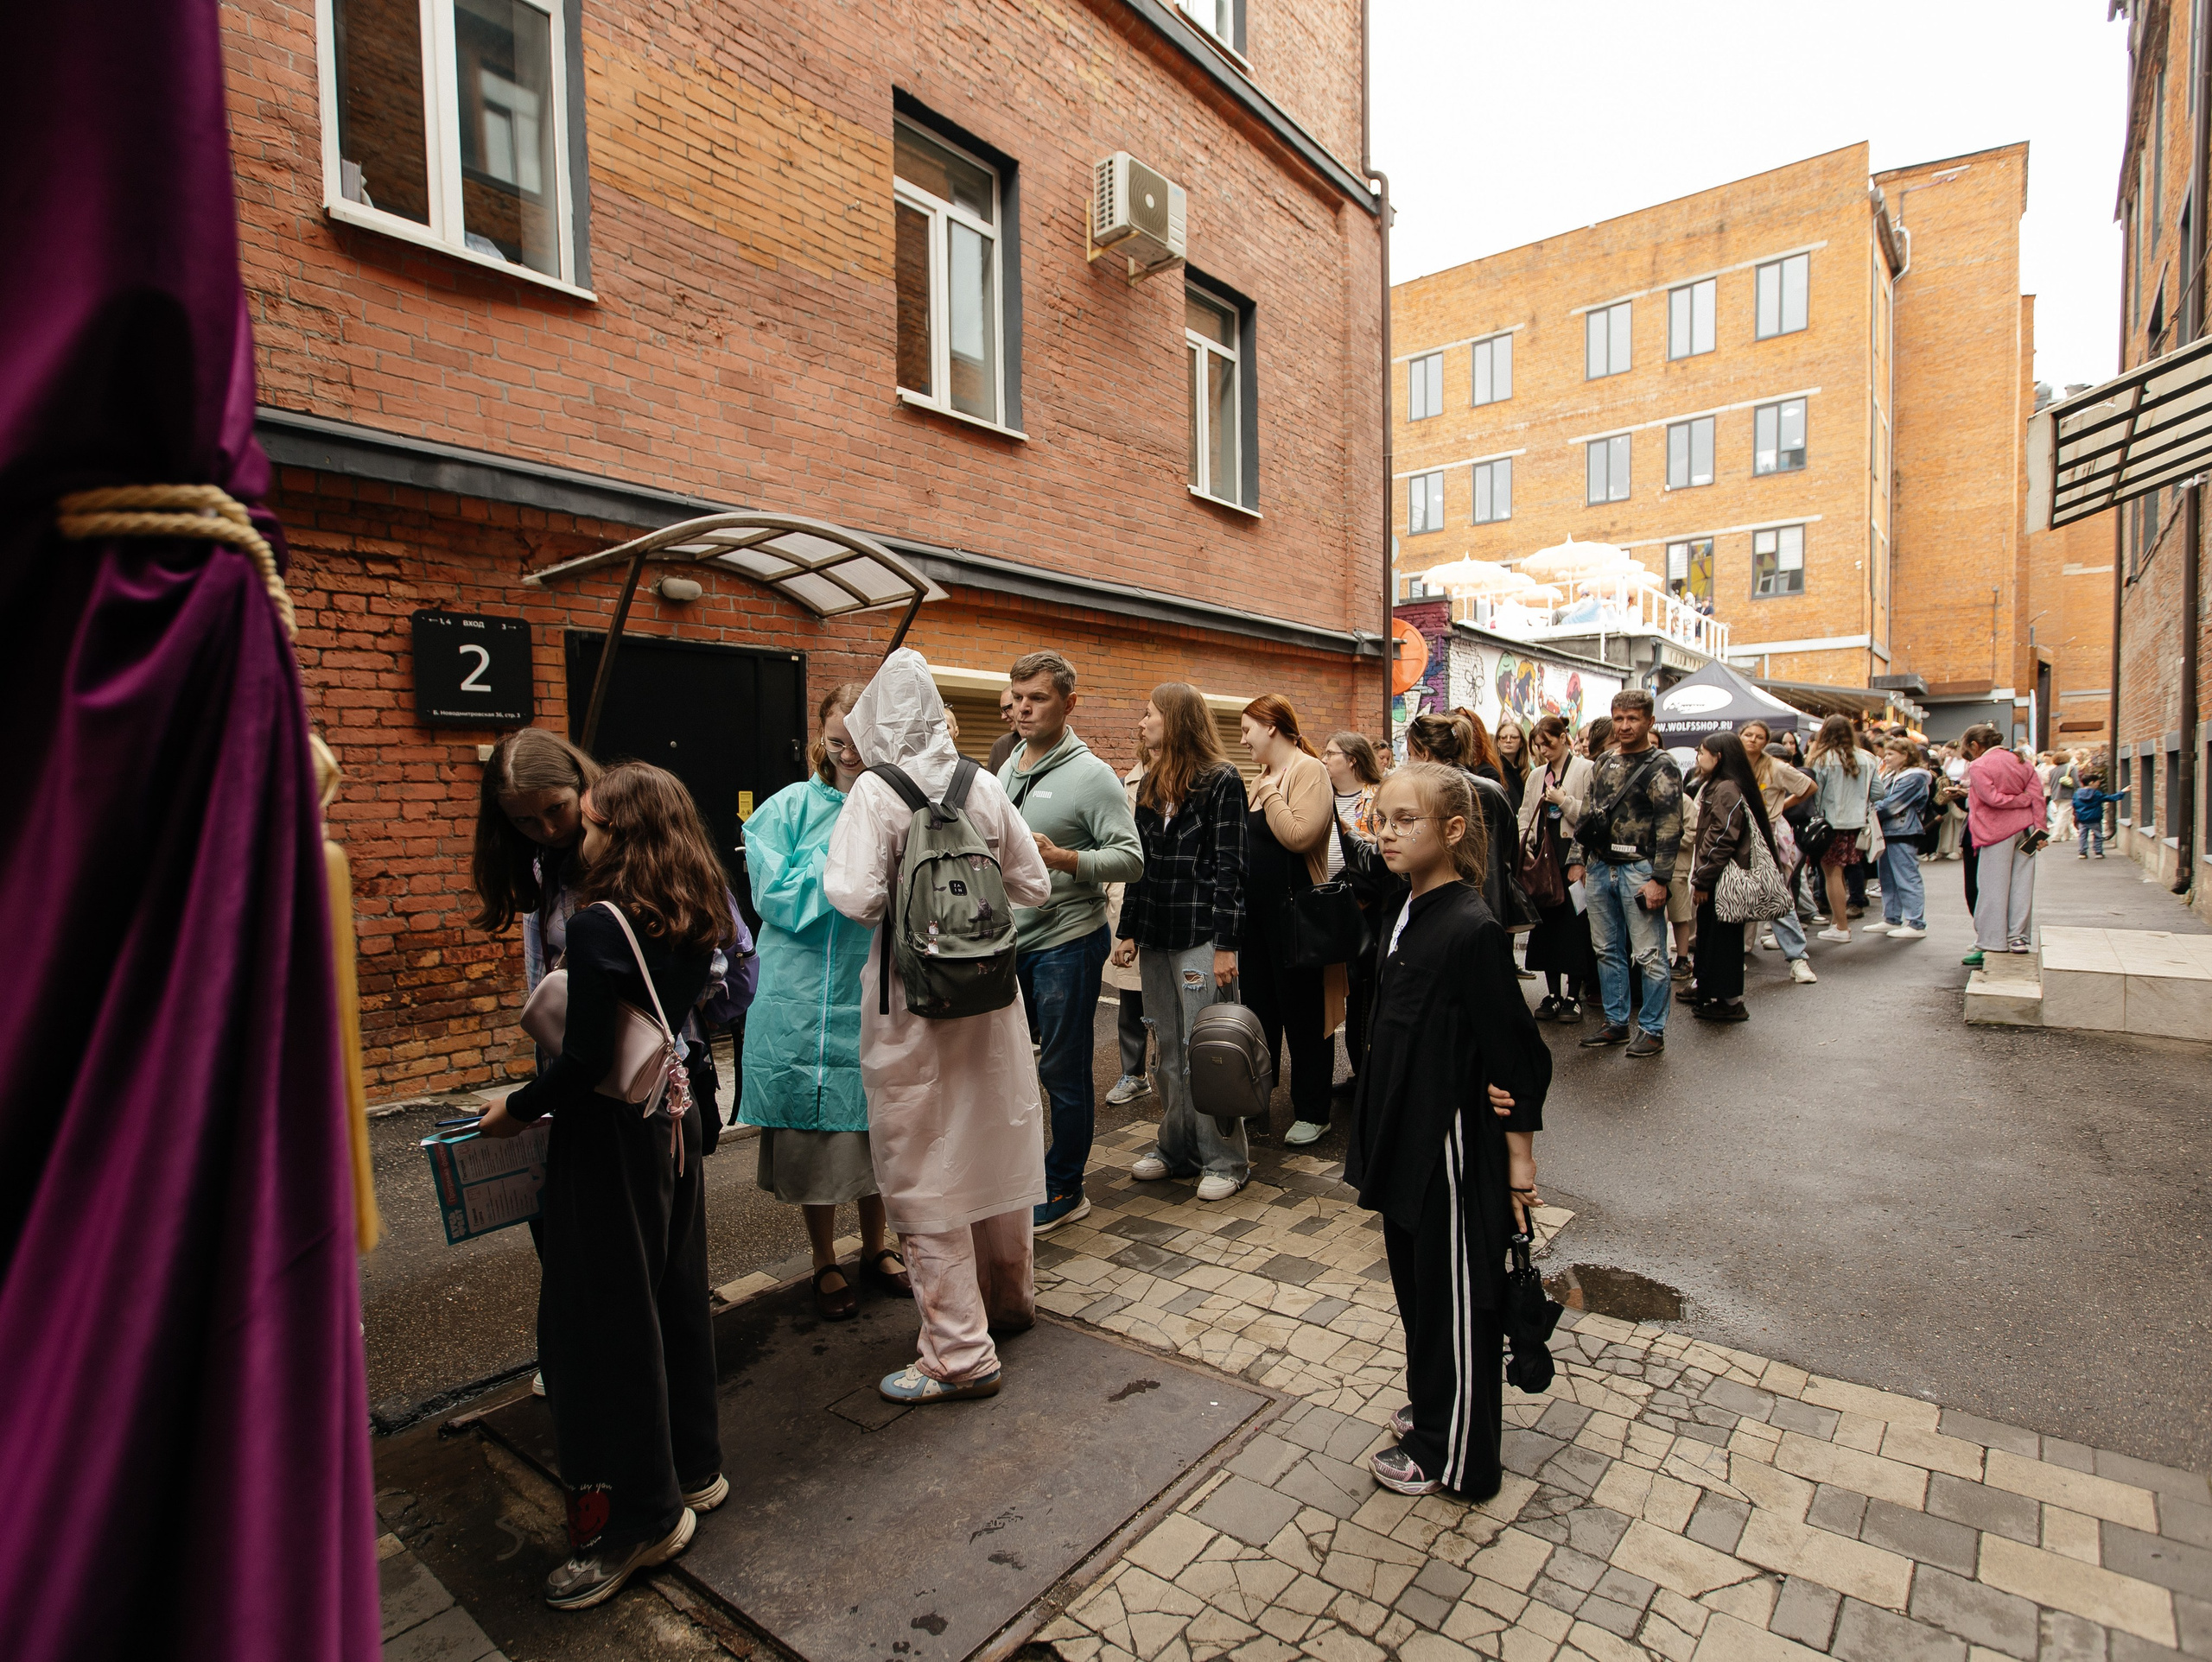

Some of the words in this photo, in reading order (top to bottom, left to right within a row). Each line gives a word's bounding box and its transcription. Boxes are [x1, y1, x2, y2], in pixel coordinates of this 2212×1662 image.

[462, 619, 485, 629] ВХОД
[459, 644, 492, 692] 2
[1653, 720, 1733, 733] WW.WOLFSSHOP.RU
